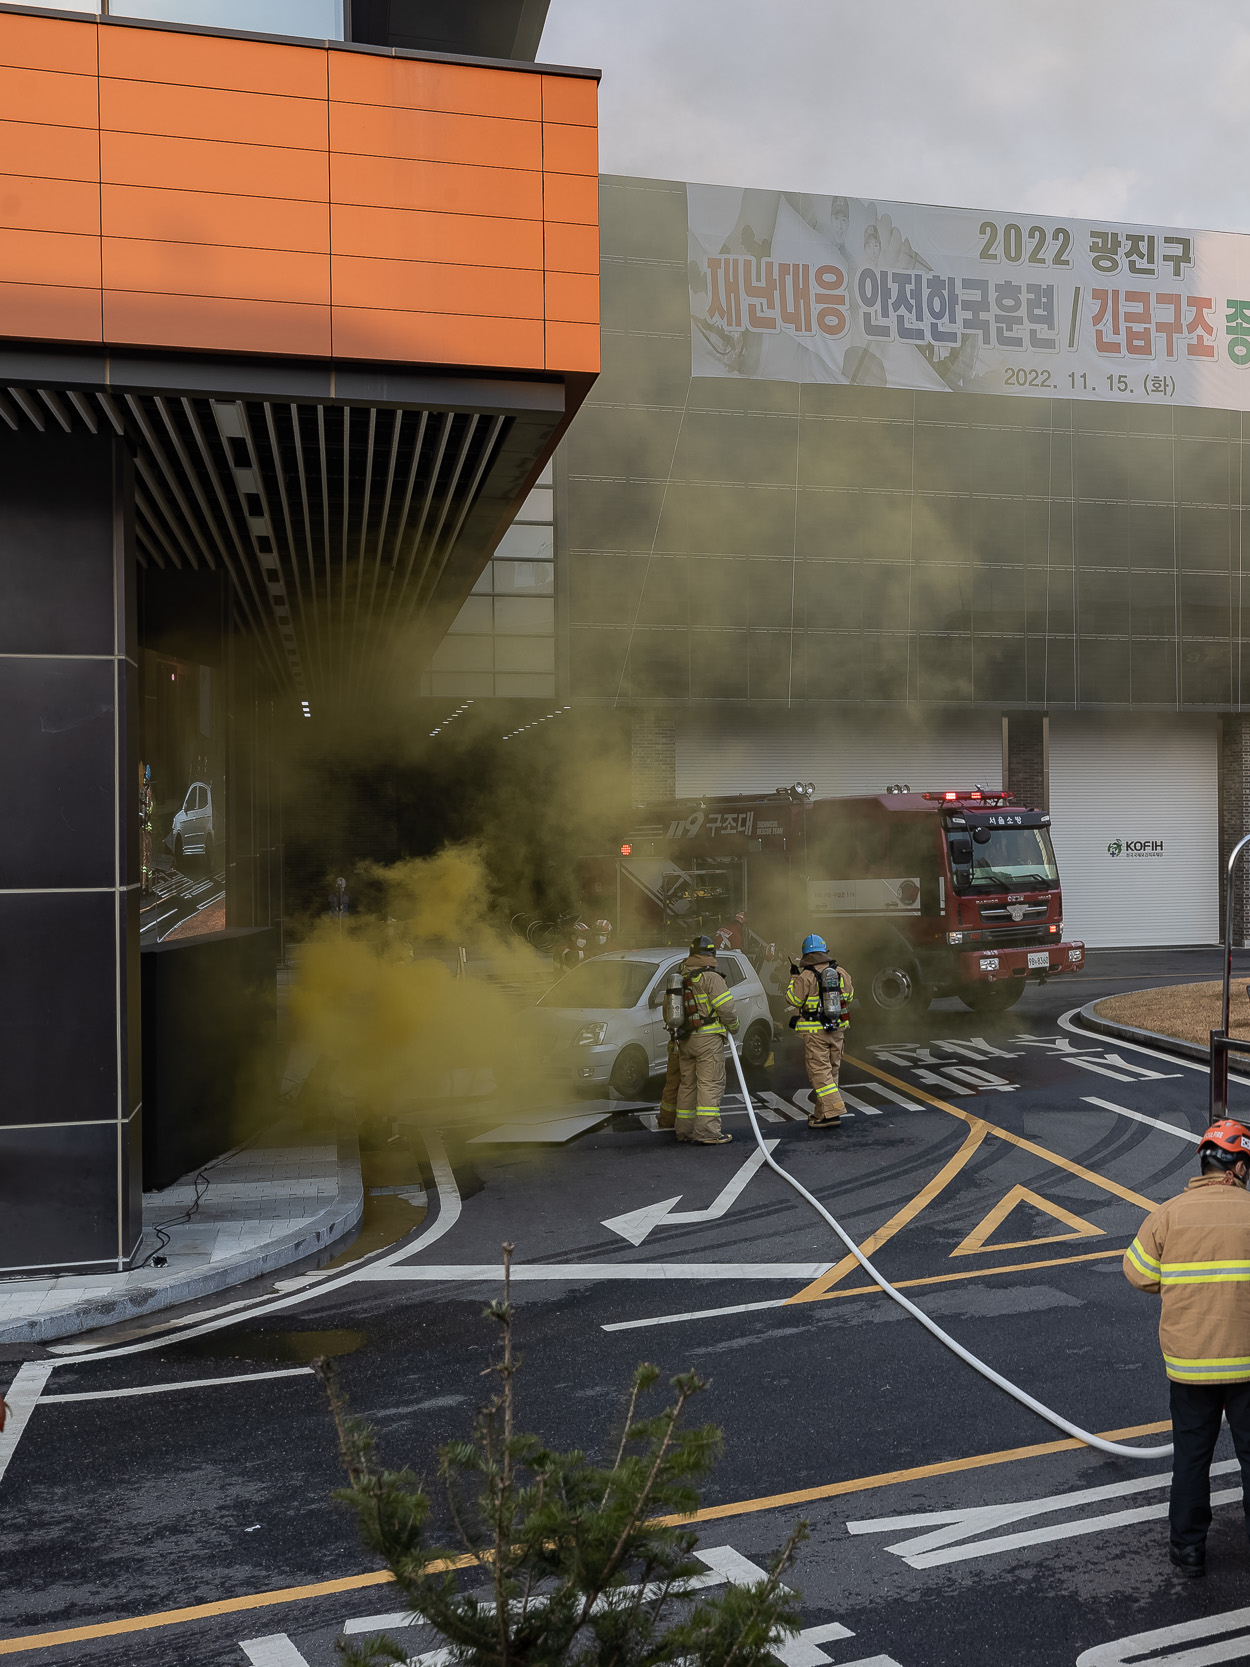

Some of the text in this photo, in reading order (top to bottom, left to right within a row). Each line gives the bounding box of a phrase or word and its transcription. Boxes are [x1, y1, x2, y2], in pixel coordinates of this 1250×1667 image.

[978, 221, 1194, 278] 2022 광진구
[706, 256, 847, 335] 재난대응
[858, 267, 1056, 349] 안전한국훈련
[1091, 290, 1215, 358] 긴급구조
[1004, 367, 1177, 397] 2022. 11. 15. (화)
[666, 811, 754, 839] 119 구조대
[989, 816, 1022, 825] 서울소방
[1125, 840, 1164, 852] KOFIH
